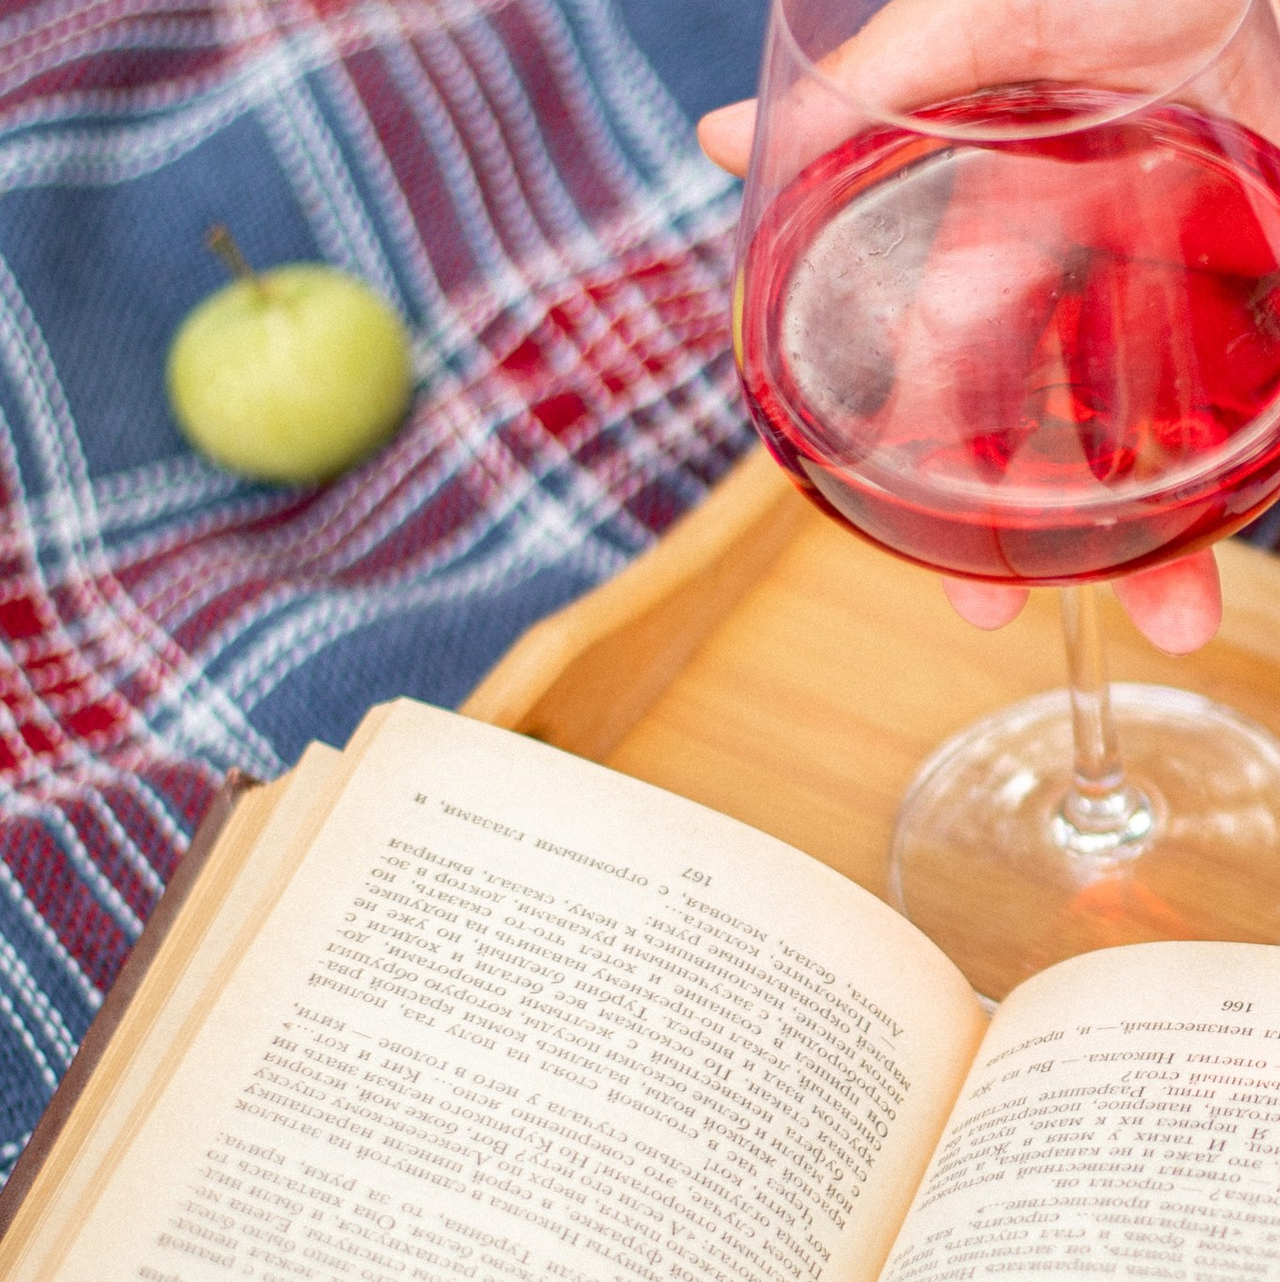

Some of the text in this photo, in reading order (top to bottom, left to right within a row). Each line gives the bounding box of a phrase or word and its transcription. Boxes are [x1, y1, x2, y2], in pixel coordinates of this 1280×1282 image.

[682, 868, 713, 887] 167
[413, 792, 904, 1037] Анюта, белая, меловая, с огромными глазами, и
[387, 837, 904, 1105] лотом пенсне, наклонившись к нему, сказал, вытирая
[665, 905, 871, 1034] Помолчите, коллега...
[370, 868, 888, 1138] Он пришел в сознание и хотел что-то сказать, но
[380, 855, 896, 1121] остробородый, с засученными рукавами, доктор в зо-
[645, 915, 911, 1092] марлей окровавленные руки:
[365, 882, 882, 1152] синеватый, лежал по-прежнему навзничь на подушке.
[1222, 1000, 1253, 1013] 166
[344, 912, 867, 1183] ставая стакан. По осколкам все бегали и ходили с
[353, 897, 875, 1168] хрустом взад и вперед. Турбин бледный, но уже не
[325, 942, 853, 1214] ной марли и белые осколки посуды, которую обрушил
[336, 929, 860, 1198] с буфета неизвестный с желтыми отворотами, до-
[1001, 1069, 1021, 1083] из
[1026, 1059, 1055, 1074] Вы
[1120, 1070, 1180, 1082] стол?
[1186, 1053, 1267, 1068] ответил
[318, 959, 846, 1231] красной жидкой воды, валялись комки красной рва-
[1038, 1083, 1146, 1101] Разрешите
[967, 1102, 1082, 1137] посвертывал
[970, 1126, 1016, 1146] пусть
[1094, 1116, 1106, 1125] к
[1118, 1116, 1143, 1125] их
[1156, 1118, 1238, 1133] перевез
[1251, 1127, 1268, 1140] Я
